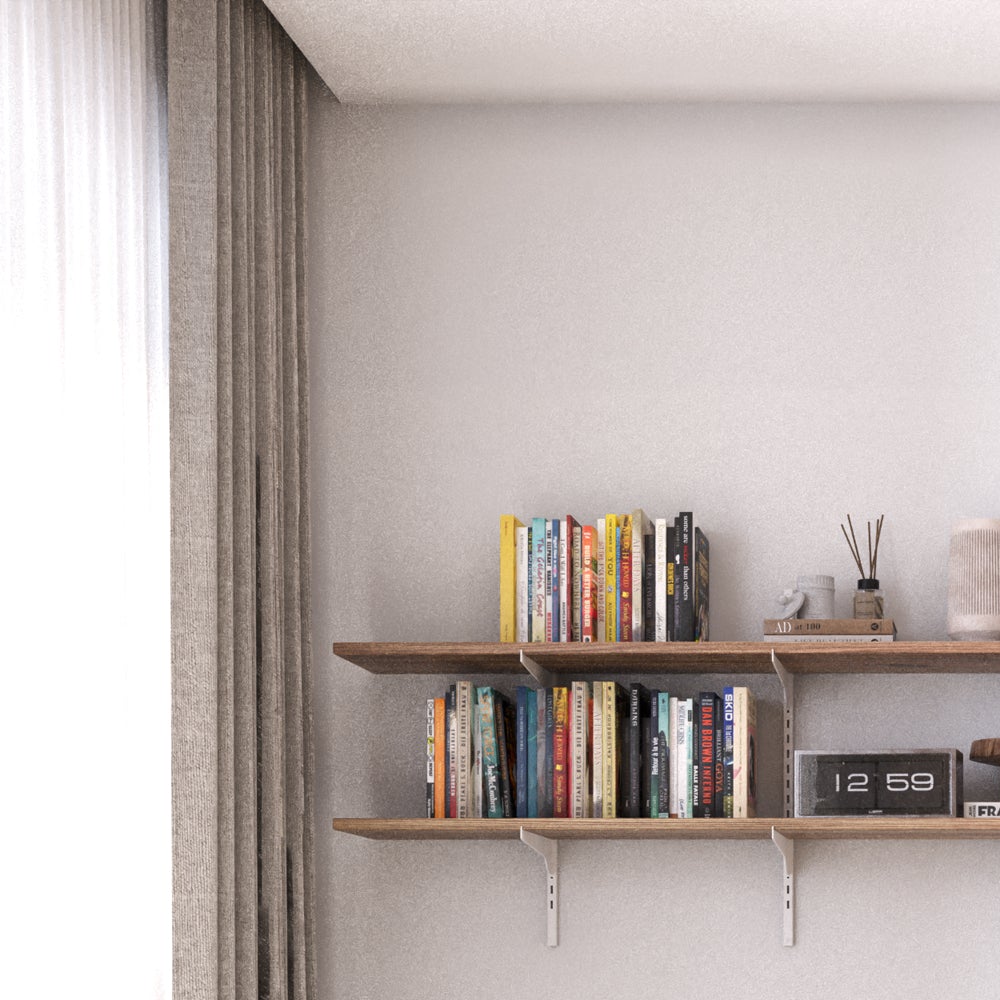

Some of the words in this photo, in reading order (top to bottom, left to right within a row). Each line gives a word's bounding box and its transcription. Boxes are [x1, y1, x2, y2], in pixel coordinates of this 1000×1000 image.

[537, 538, 545, 552] The
[574, 558, 580, 568] TO
[775, 622, 792, 632] AD
[702, 706, 713, 726] DAN
[725, 694, 733, 722] SKID
[702, 728, 713, 763] BROWN
[702, 766, 713, 804] INFERNO
[716, 763, 724, 793] GOYA
[836, 772, 868, 792] 12
[886, 772, 934, 792] 59
